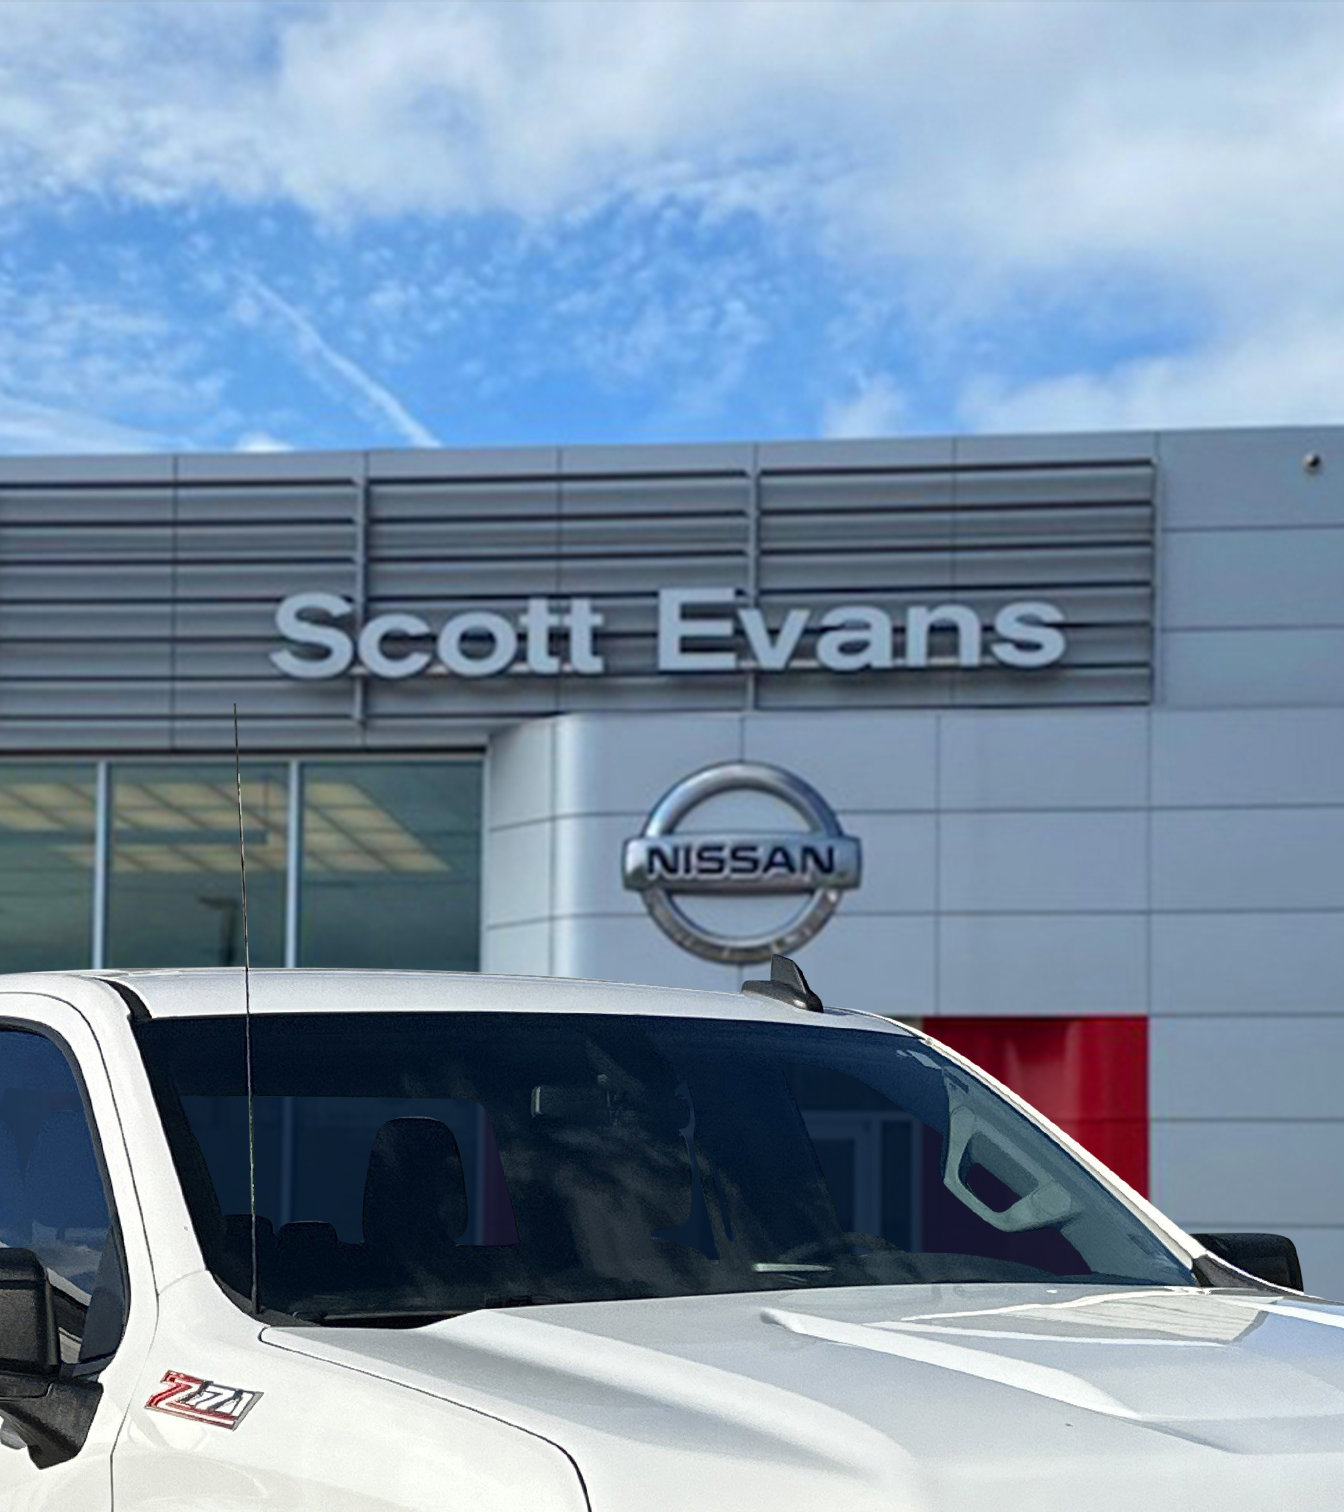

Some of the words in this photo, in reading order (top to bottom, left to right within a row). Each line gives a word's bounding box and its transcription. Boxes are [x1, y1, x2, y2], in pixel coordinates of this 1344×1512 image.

[268, 589, 604, 678] Scott
[657, 587, 1068, 672] Evans
[646, 845, 835, 877] NISSAN
[143, 1369, 264, 1431] Z71
